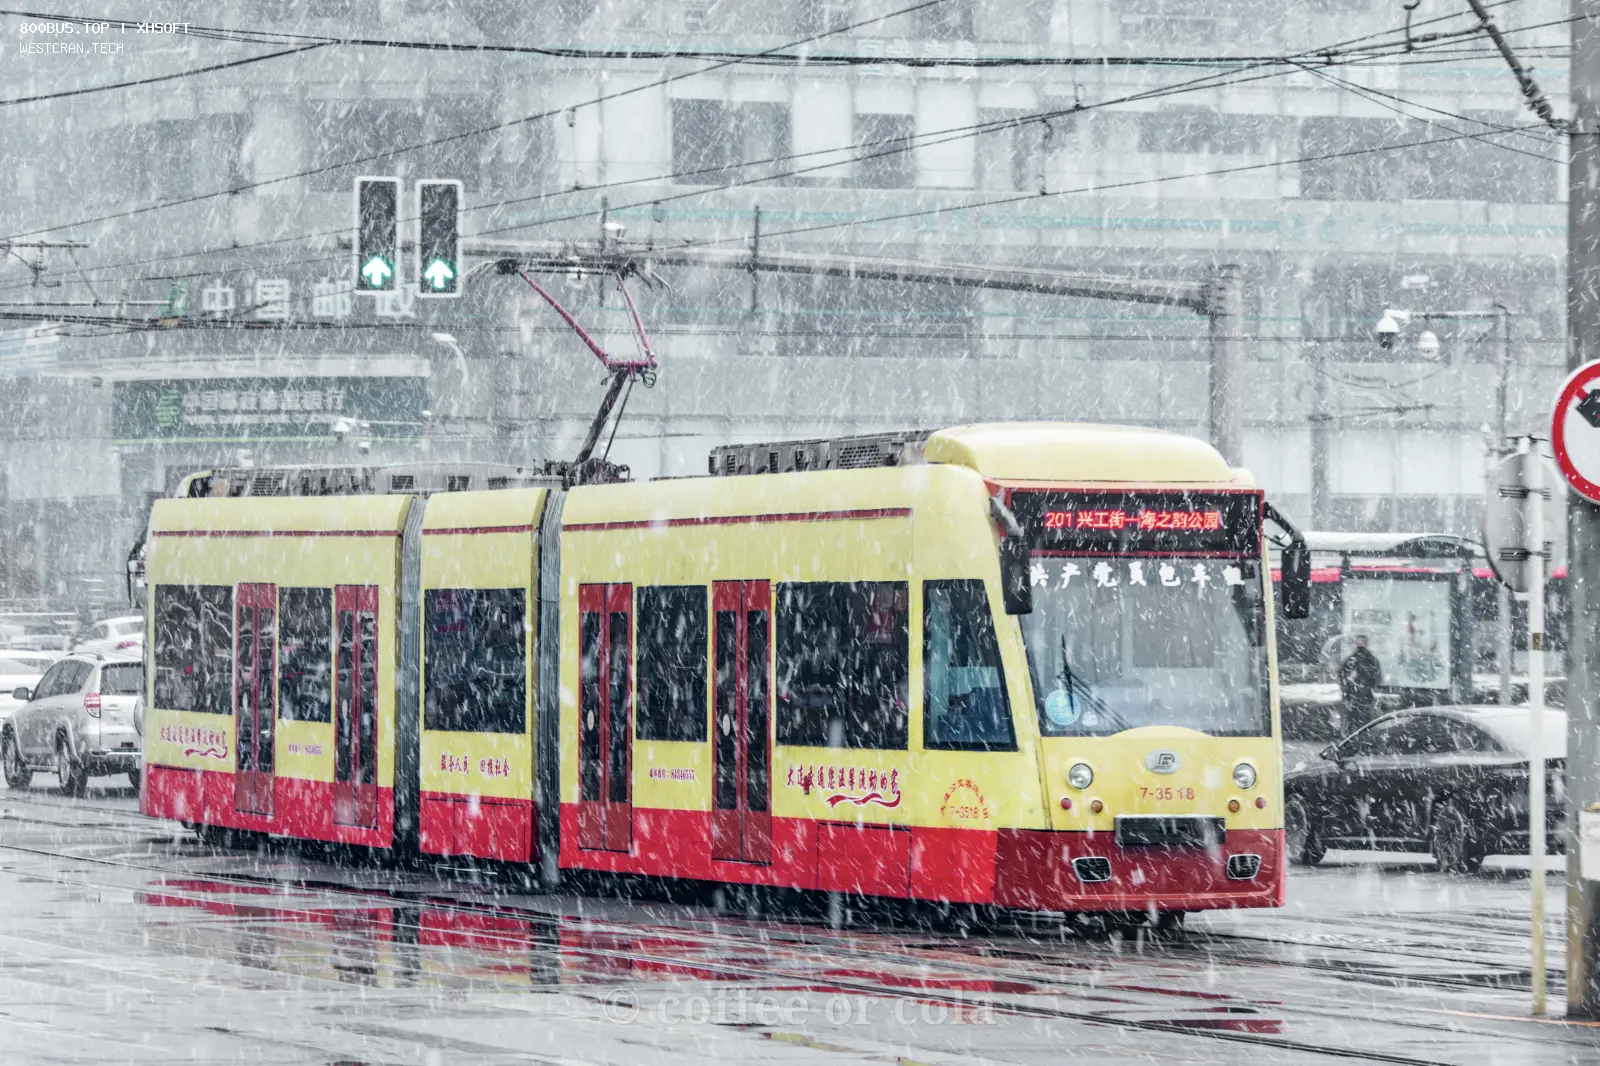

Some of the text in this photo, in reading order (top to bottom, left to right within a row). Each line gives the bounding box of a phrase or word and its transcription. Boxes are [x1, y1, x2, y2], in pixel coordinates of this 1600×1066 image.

[202, 278, 416, 320] 中国邮政
[1045, 512, 1072, 528] 201
[1140, 787, 1195, 801] 7-3518
